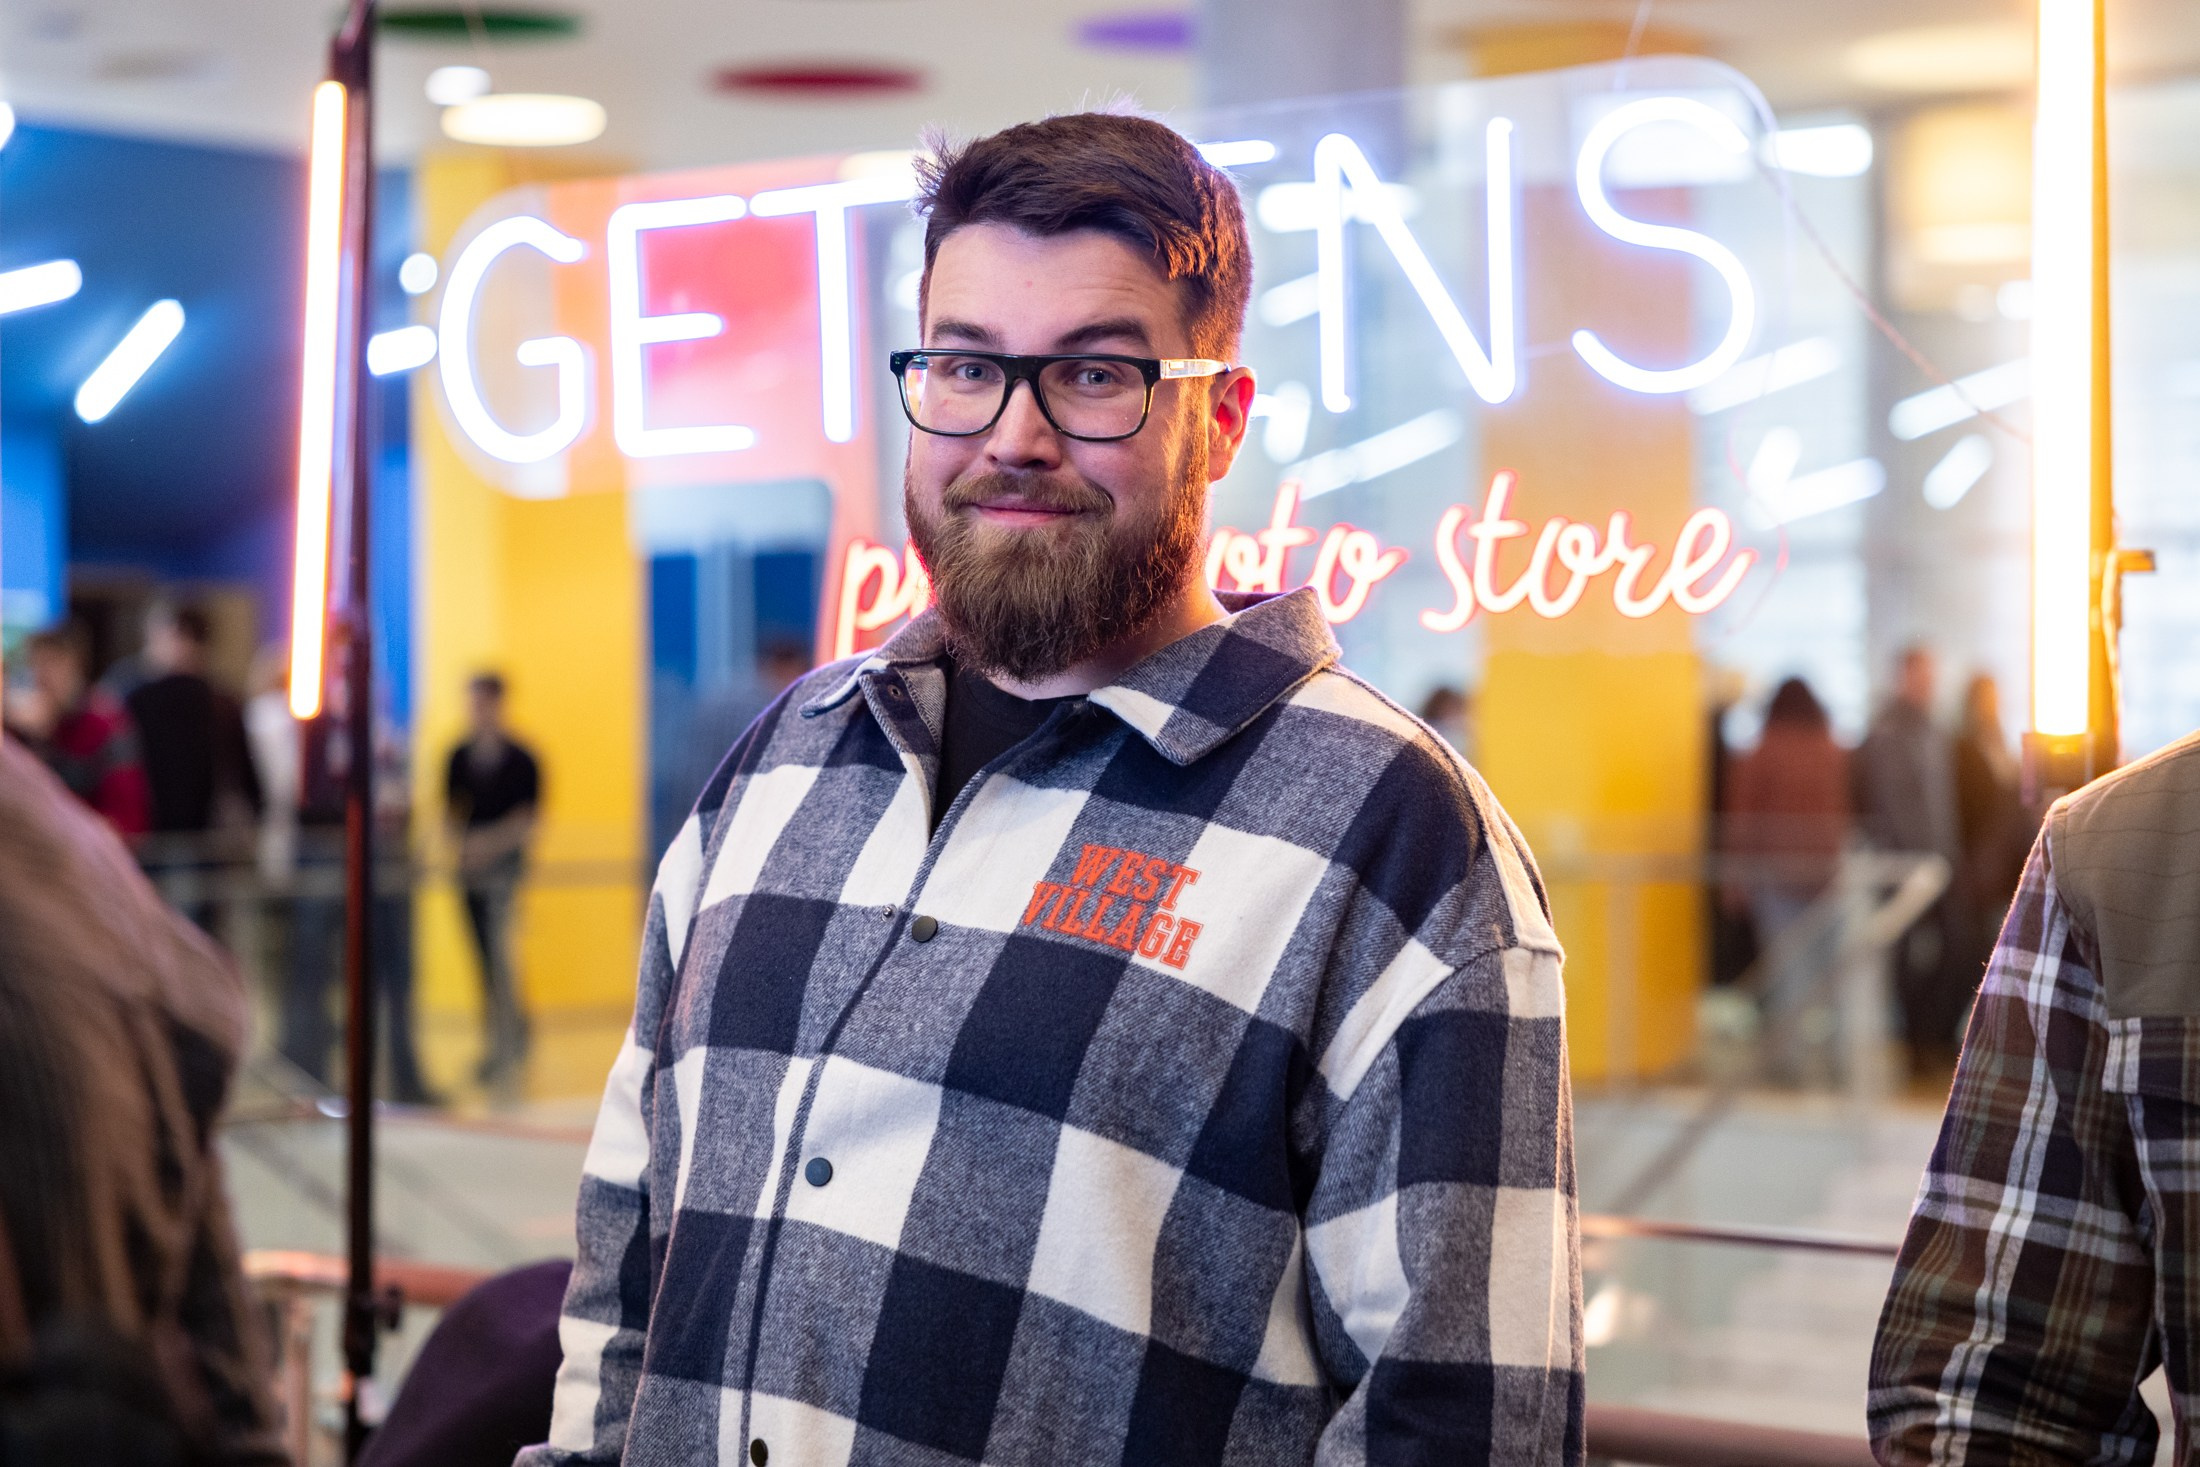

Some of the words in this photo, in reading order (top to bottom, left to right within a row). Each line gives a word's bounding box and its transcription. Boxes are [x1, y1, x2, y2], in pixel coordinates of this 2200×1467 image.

[1420, 469, 1757, 633] store
[1070, 843, 1202, 912] WEST
[1022, 880, 1204, 971] VILLAGE
